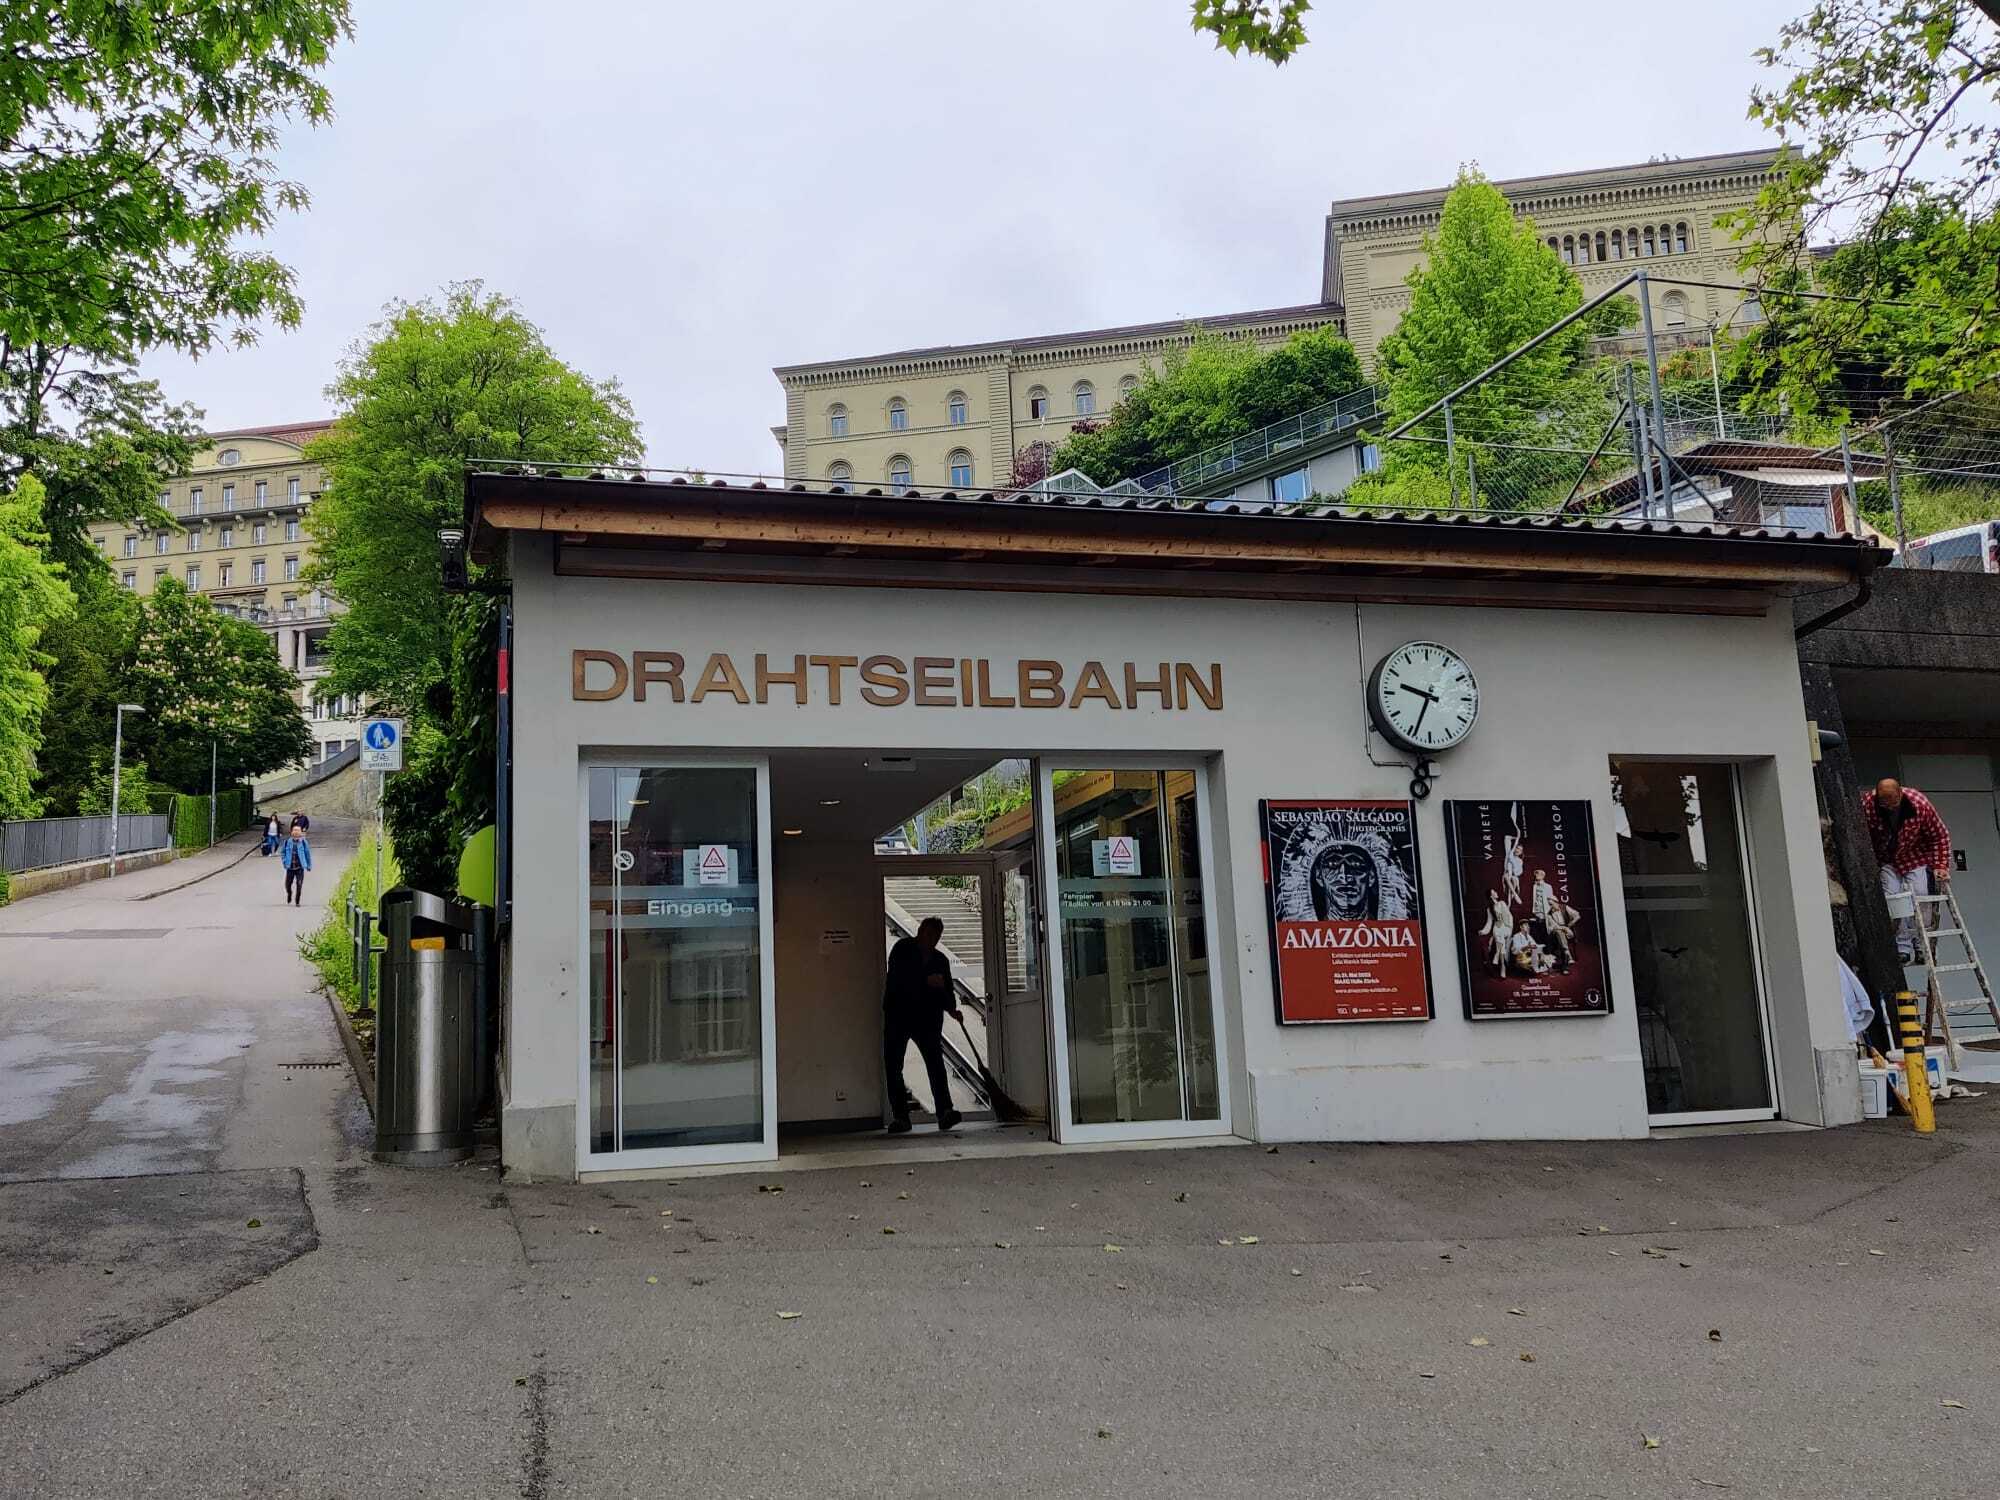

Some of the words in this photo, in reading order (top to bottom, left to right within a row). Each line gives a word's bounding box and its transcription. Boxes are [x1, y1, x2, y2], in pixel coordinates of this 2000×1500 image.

[572, 649, 1224, 710] DRAHTSEILBAHN
[1345, 811, 1405, 823] SALGADO
[1552, 804, 1570, 903] CALEIDOSKOP
[1063, 892, 1095, 902] Fahrplan
[1122, 899, 1132, 907] bis
[647, 899, 733, 918] Eingang
[1283, 923, 1416, 948] AMAZÔNIA
